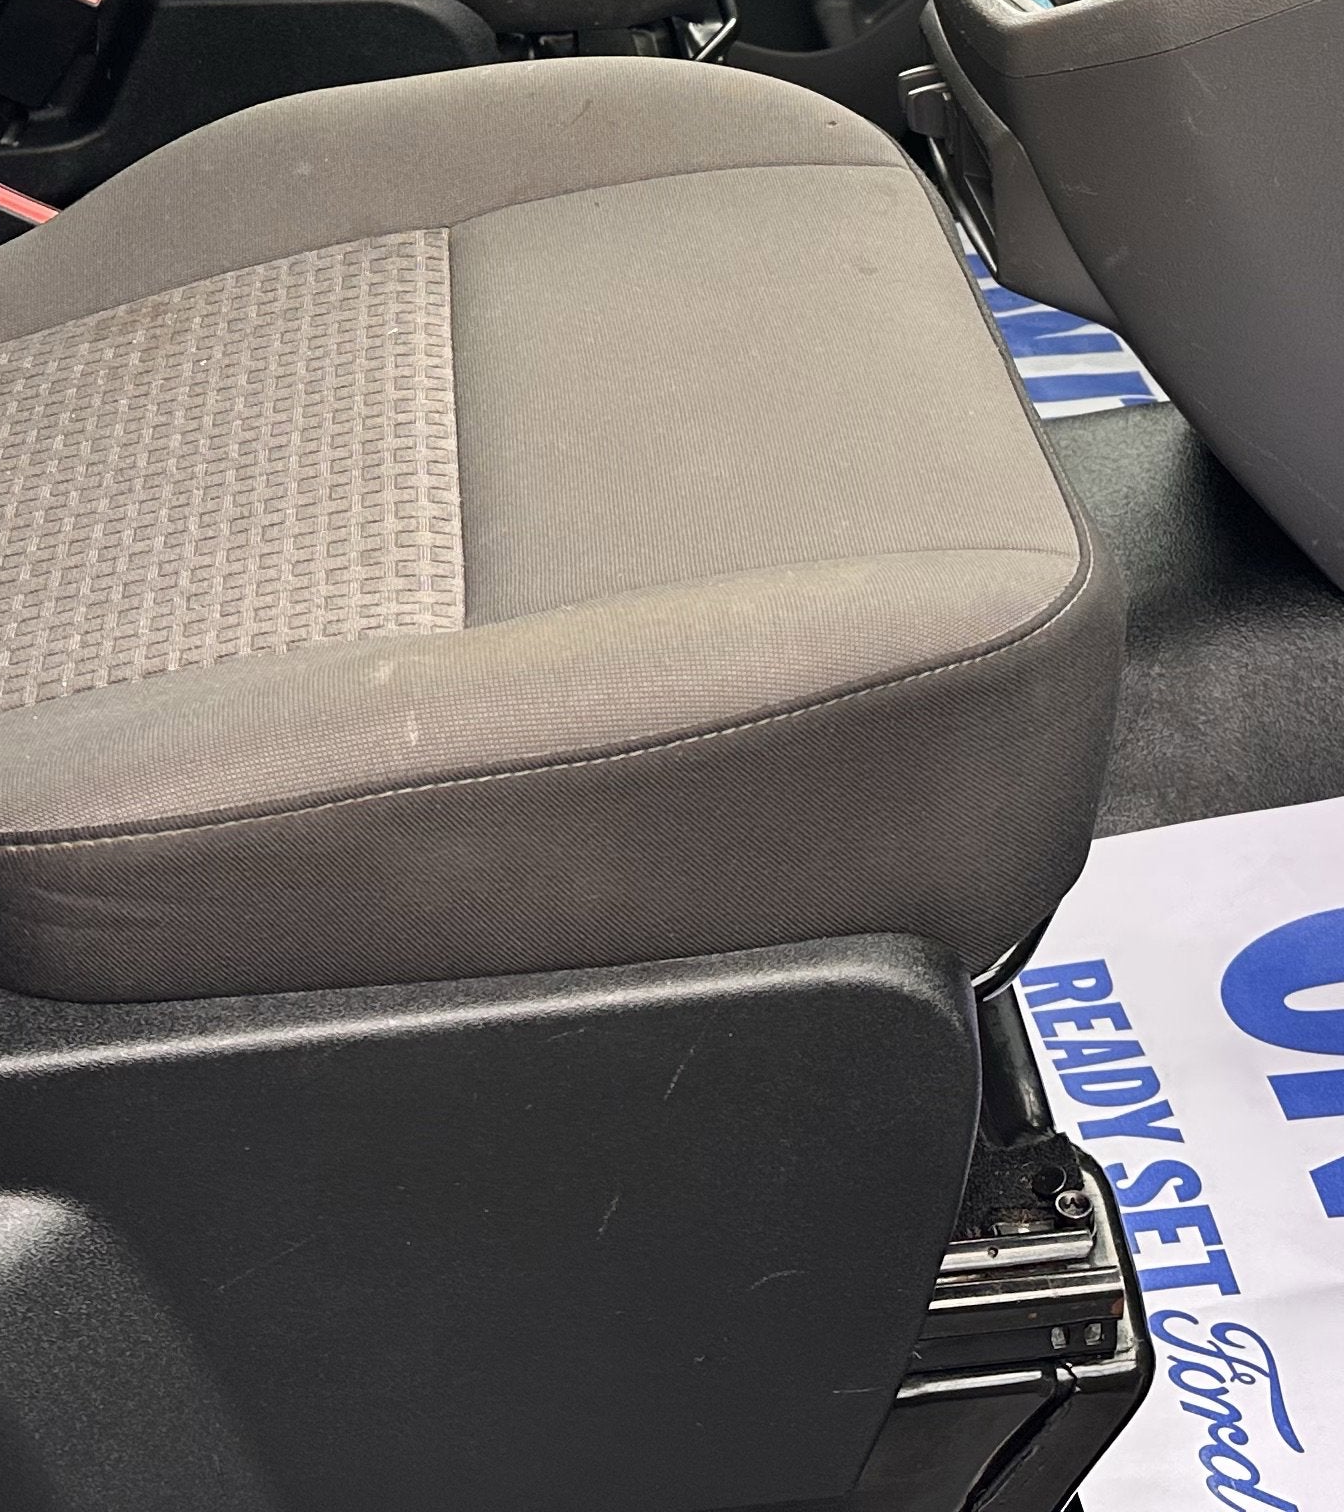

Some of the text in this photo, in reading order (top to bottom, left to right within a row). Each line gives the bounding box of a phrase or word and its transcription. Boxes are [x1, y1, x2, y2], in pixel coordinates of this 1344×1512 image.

[1017, 957, 1306, 1512] READY SET Ford
